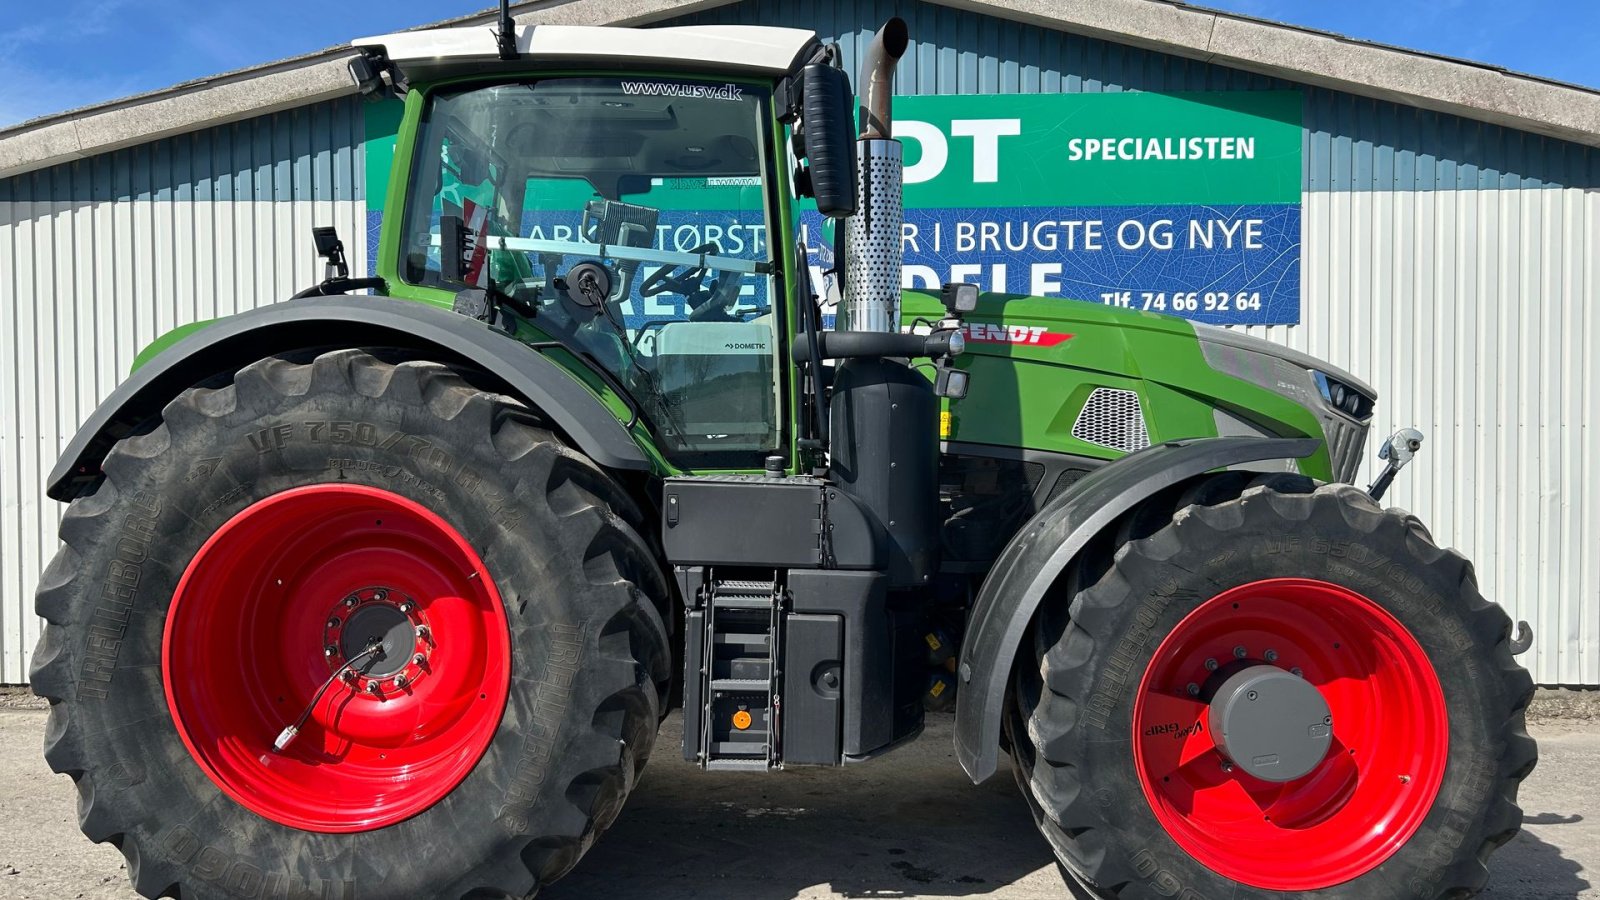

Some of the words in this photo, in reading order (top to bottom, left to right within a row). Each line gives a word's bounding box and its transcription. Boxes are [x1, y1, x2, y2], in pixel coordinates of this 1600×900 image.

[621, 81, 743, 101] www.usv.dk
[1067, 136, 1255, 161] SPECIALISTEN
[956, 220, 1103, 252] BRUGTE
[1116, 219, 1174, 250] OG
[1188, 218, 1264, 249] NYE
[1141, 292, 1167, 311] 74
[1172, 292, 1198, 311] 66
[1203, 292, 1230, 311] 92
[1235, 292, 1262, 311] 64
[734, 342, 766, 350] DOMETIC
[245, 423, 294, 455] VF
[77, 489, 163, 701] TRELLEBORG
